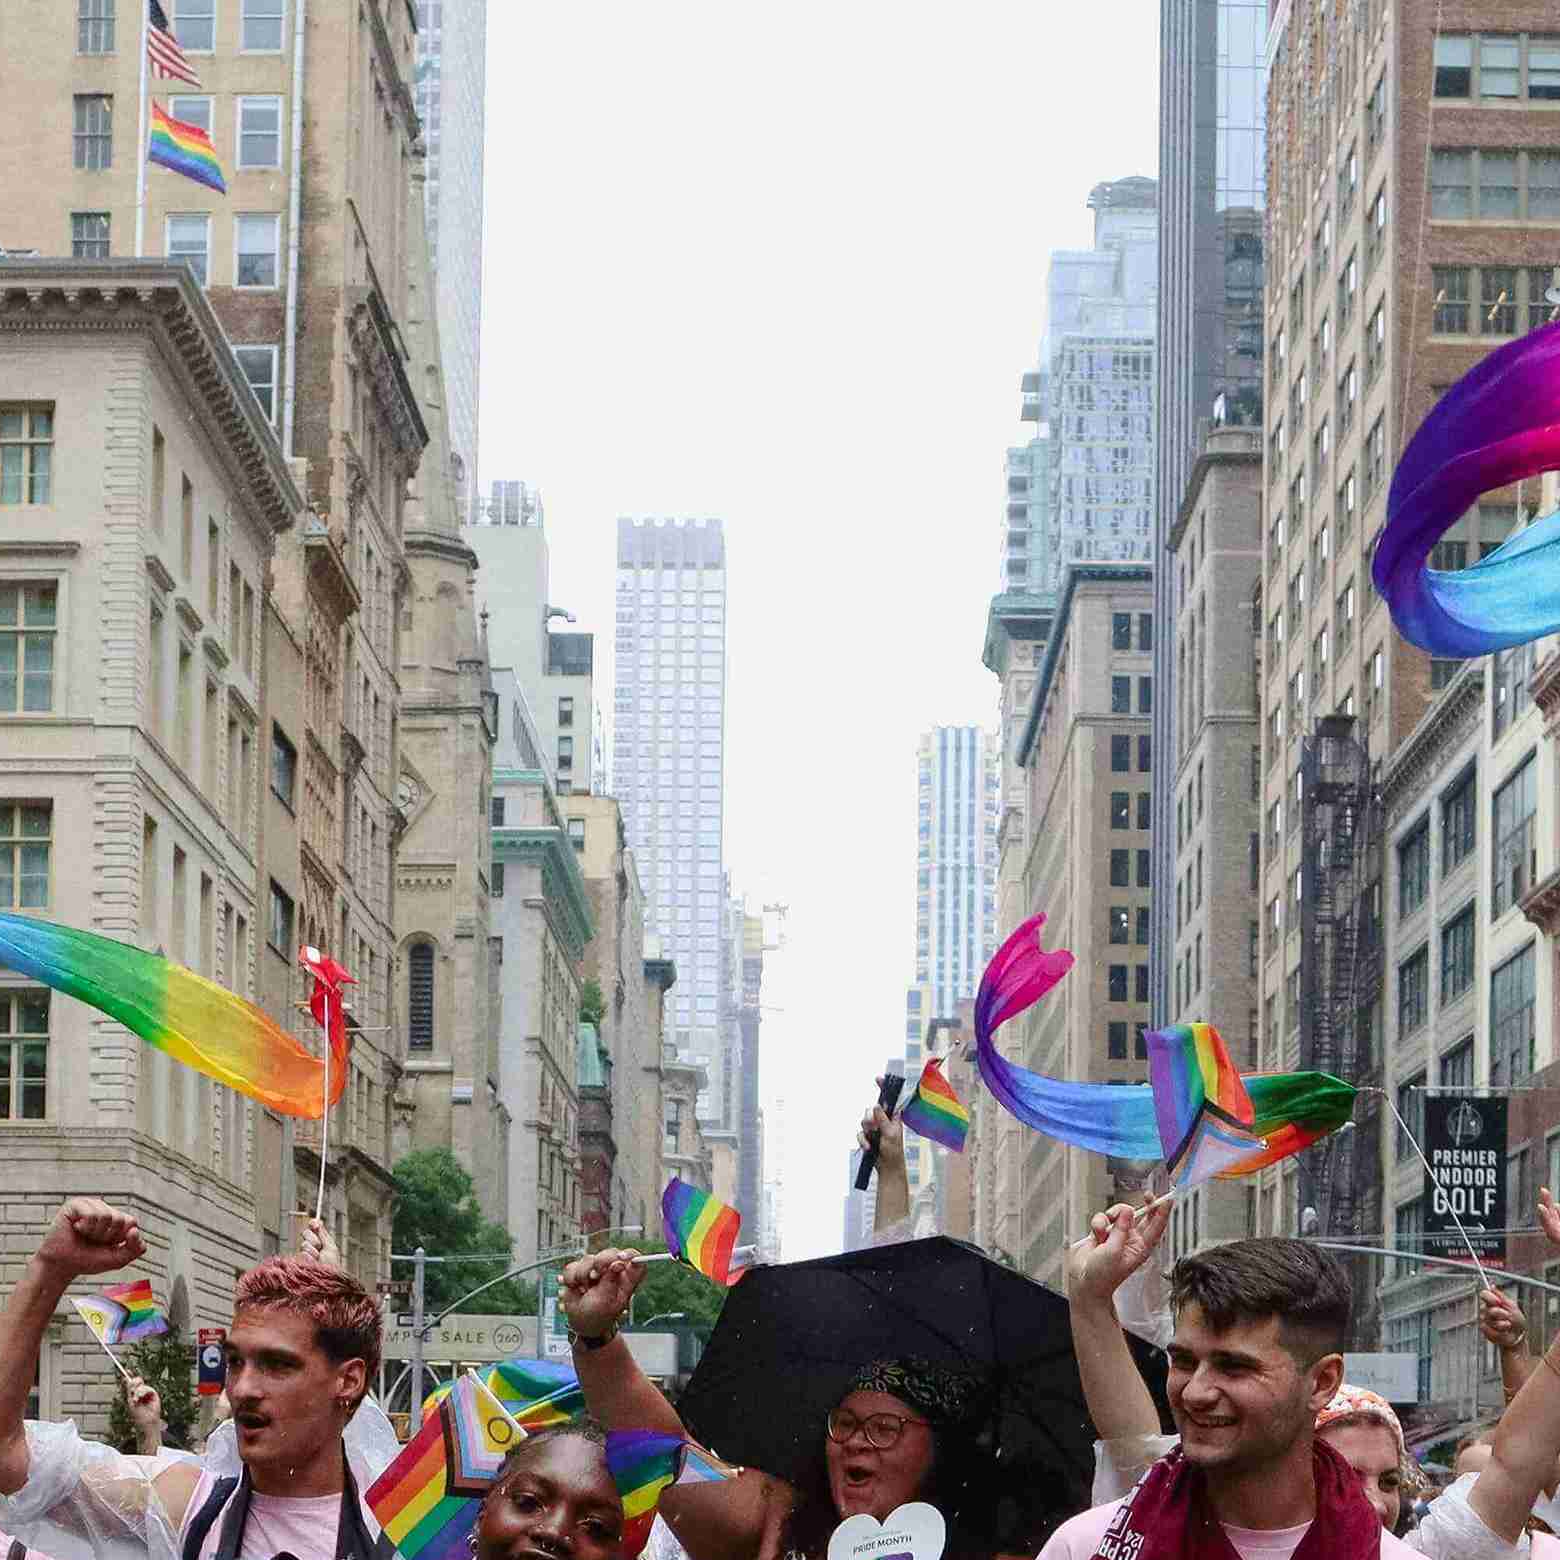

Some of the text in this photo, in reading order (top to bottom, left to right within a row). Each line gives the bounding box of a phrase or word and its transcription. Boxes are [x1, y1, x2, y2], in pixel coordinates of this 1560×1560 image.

[1433, 1150, 1497, 1166] PREMIER
[1433, 1167, 1497, 1186] INDOOR
[1433, 1187, 1497, 1215] GOLF
[441, 1331, 486, 1343] SALE
[853, 1542, 876, 1555] PRIDE
[877, 1534, 912, 1548] MONTH
